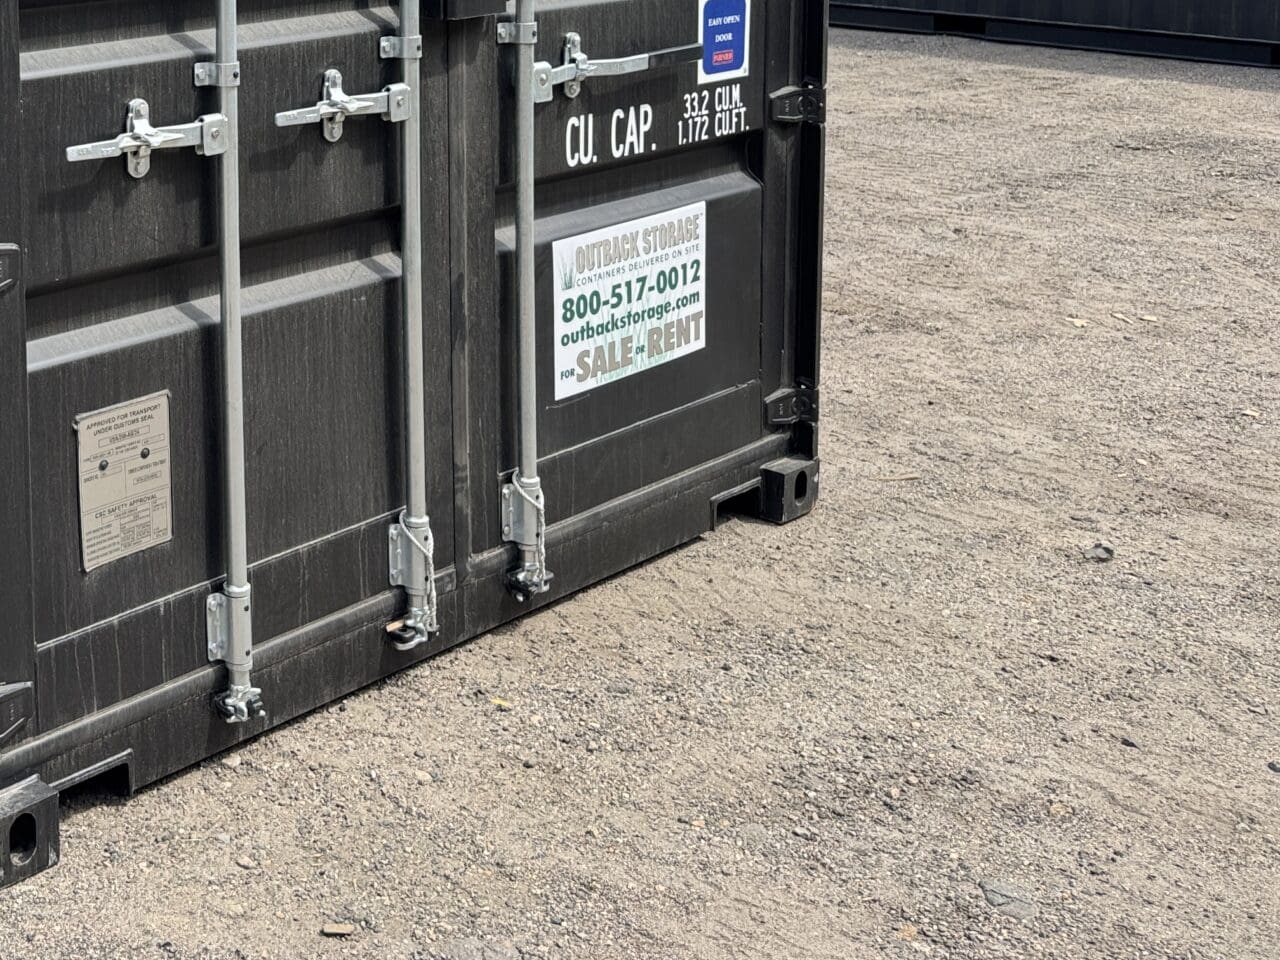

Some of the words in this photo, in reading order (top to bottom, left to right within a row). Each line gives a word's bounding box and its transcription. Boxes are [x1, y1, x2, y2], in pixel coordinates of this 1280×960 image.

[708, 17, 723, 27] EASY
[723, 15, 740, 25] OPEN
[714, 32, 733, 43] DOOR
[565, 113, 597, 168] CU.
[611, 103, 656, 158] CAP.
[683, 90, 709, 118] 33.2
[575, 230, 640, 275] OUTBACK
[642, 214, 700, 254] STORAGE
[576, 266, 626, 287] CONTAINERS
[628, 253, 669, 272] DELIVERED
[672, 249, 683, 259] ON
[685, 244, 700, 256] SITE
[560, 291, 700, 347] outbackstorage.com
[561, 258, 701, 324] 800-517-0012
[560, 367, 576, 381] FOR
[576, 335, 633, 383] SALE
[635, 344, 645, 355] OR
[647, 310, 704, 359] RENT
